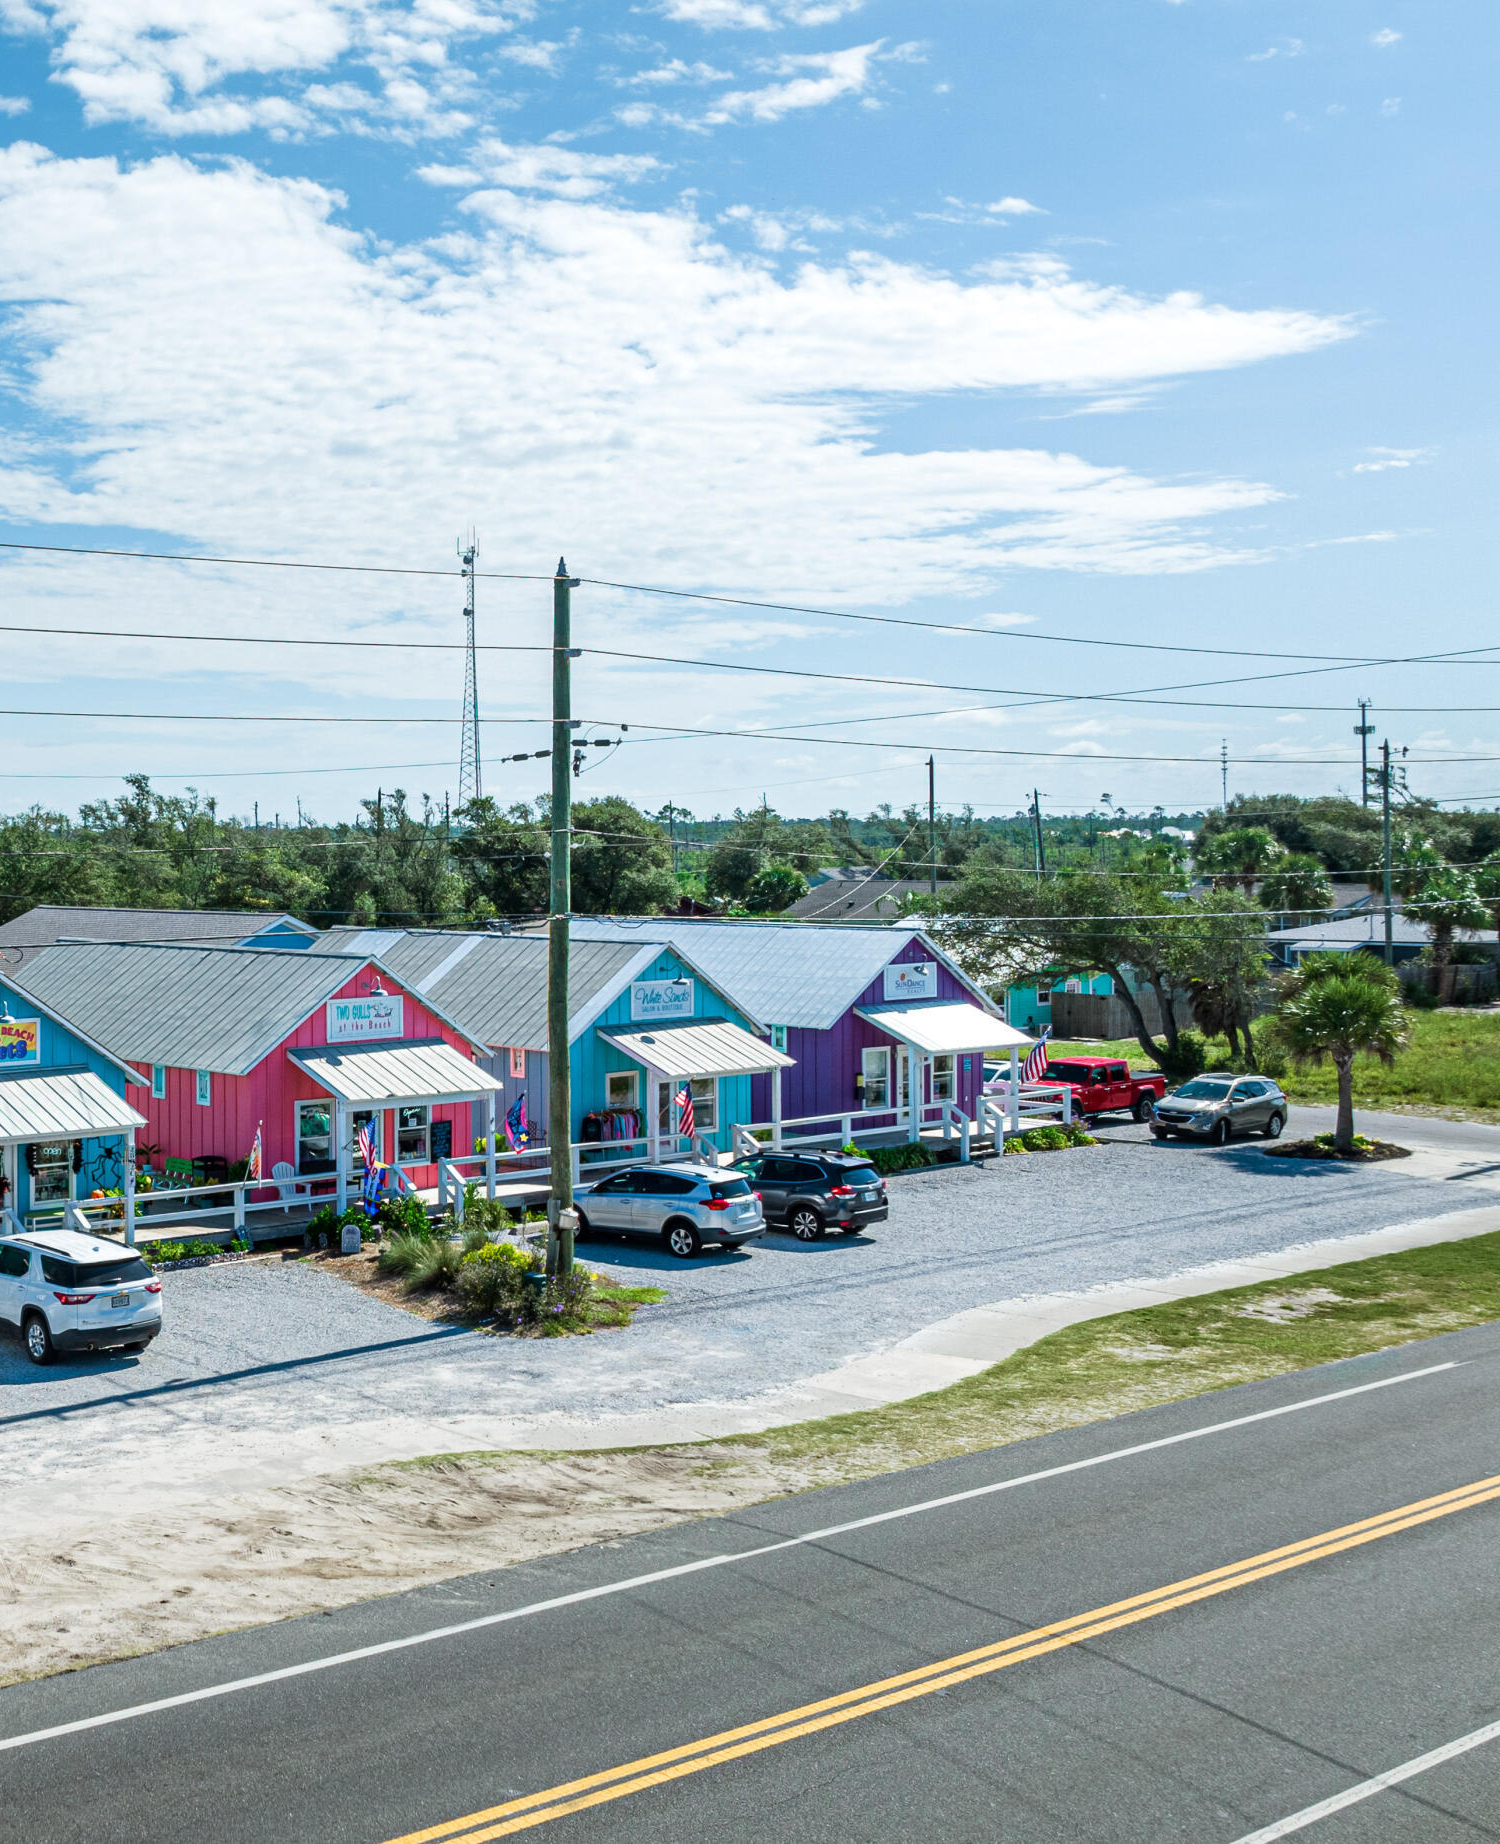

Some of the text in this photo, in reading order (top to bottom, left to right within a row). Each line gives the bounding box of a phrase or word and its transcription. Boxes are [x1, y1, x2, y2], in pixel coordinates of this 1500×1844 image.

[635, 986, 690, 1004] White Sands
[336, 1003, 371, 1020] TWO GULLS
[0, 1026, 35, 1042] BEACH
